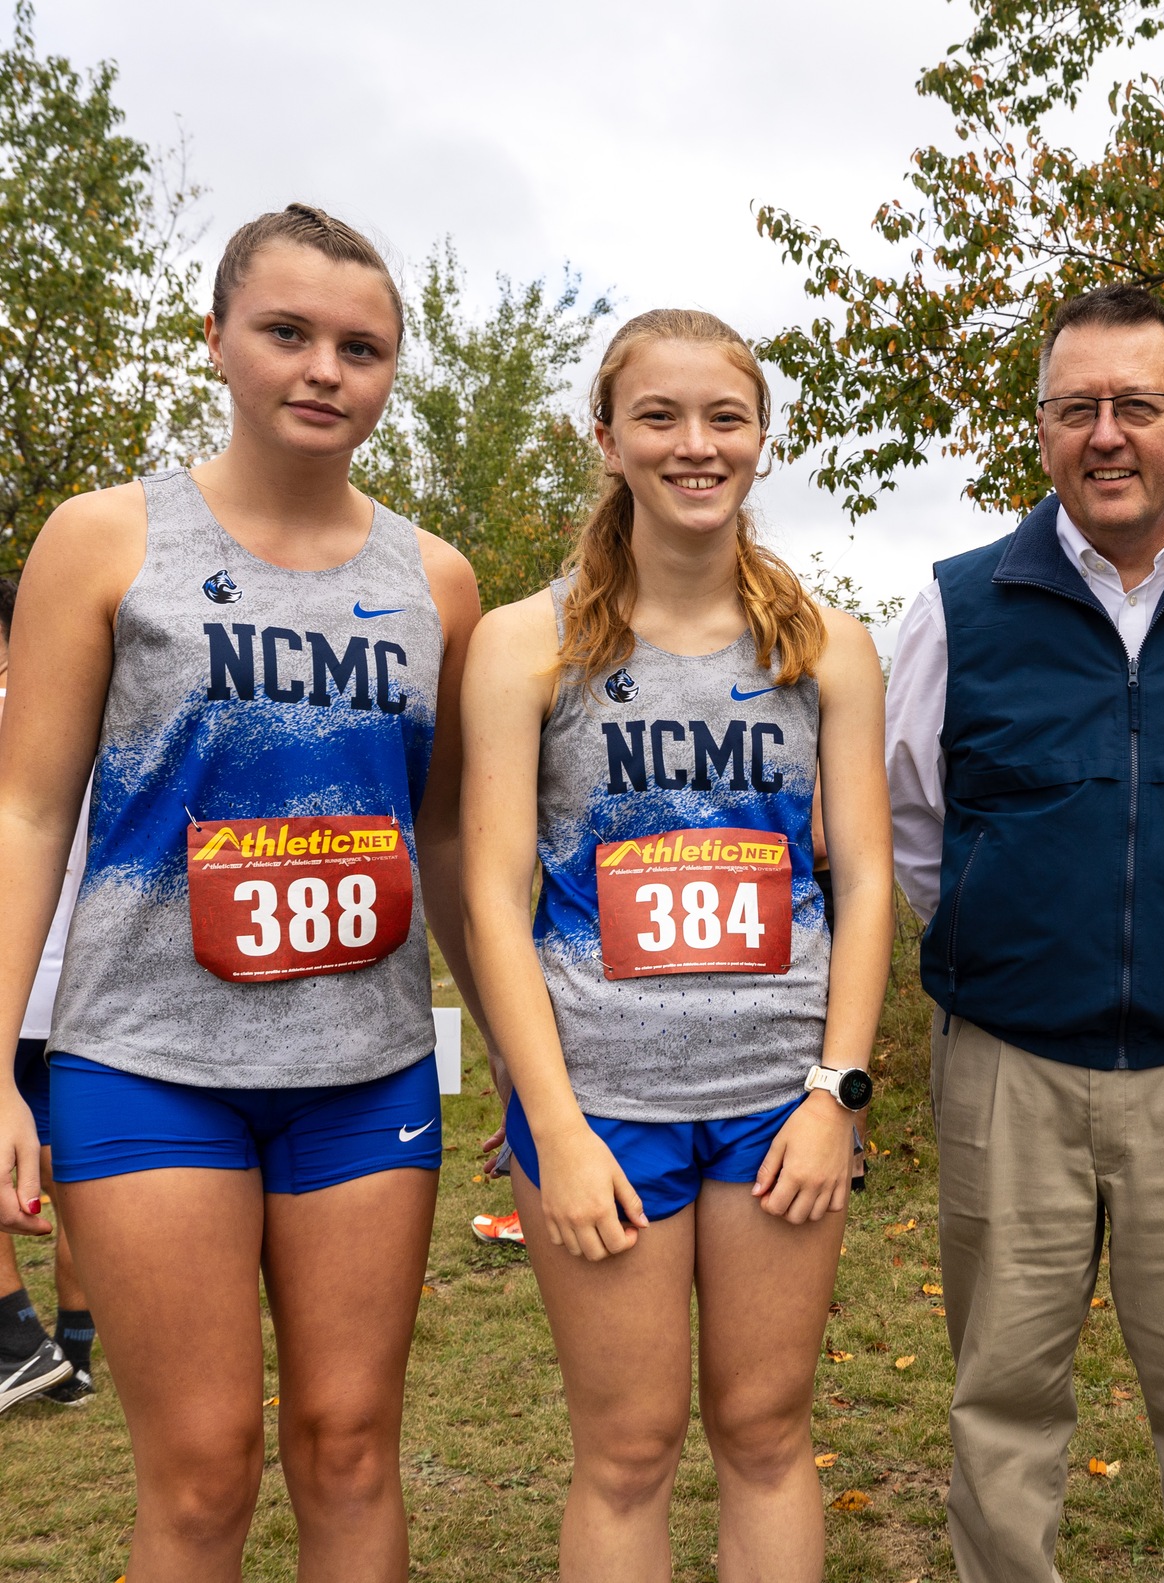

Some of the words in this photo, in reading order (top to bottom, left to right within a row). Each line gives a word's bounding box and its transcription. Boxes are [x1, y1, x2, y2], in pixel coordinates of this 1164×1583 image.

[203, 623, 407, 715] NCMC
[602, 720, 784, 794] NCMC
[233, 874, 377, 956] 388
[635, 881, 765, 952] 384
